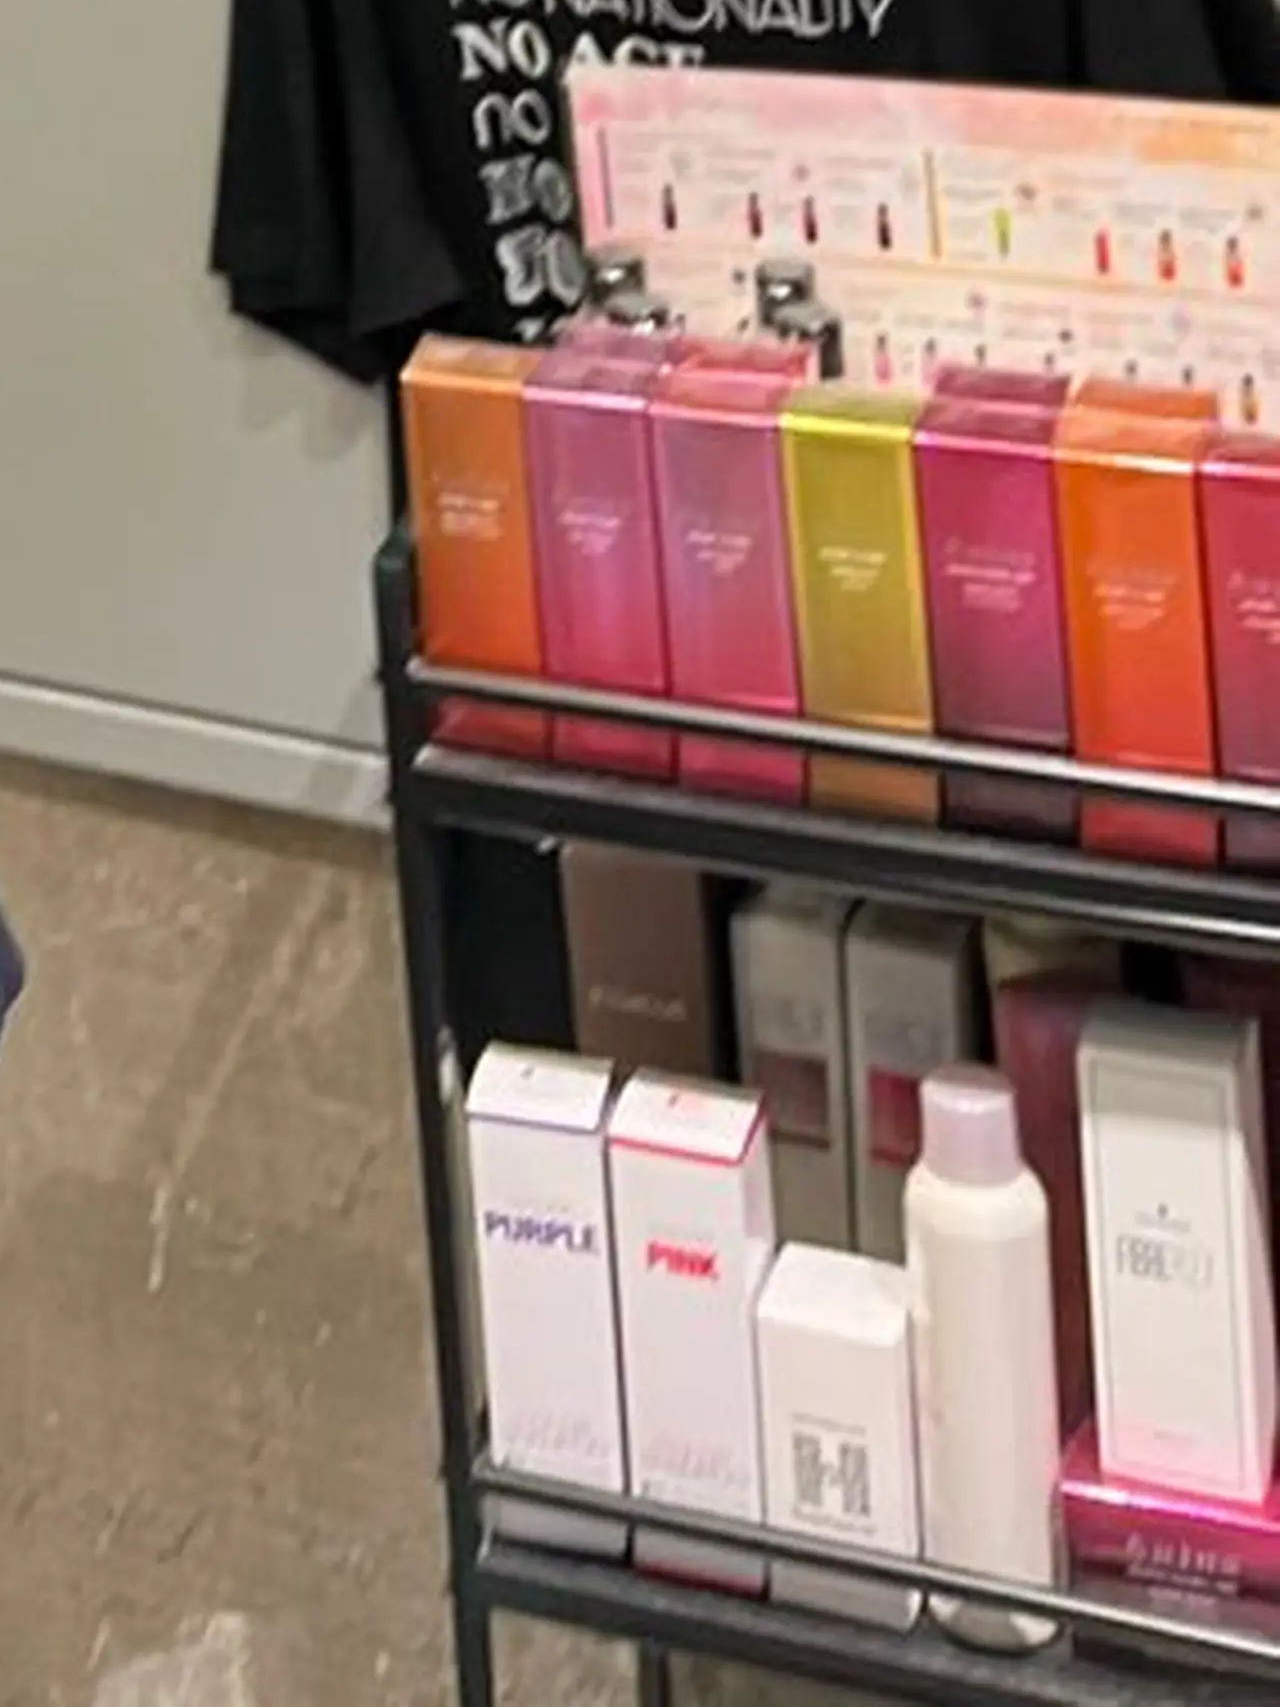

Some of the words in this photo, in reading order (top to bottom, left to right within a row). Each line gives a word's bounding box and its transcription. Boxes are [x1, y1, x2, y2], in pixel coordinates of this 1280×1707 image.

[452, 16, 551, 81] NO
[484, 1209, 600, 1257] PURPLE
[647, 1239, 720, 1283] PINK
